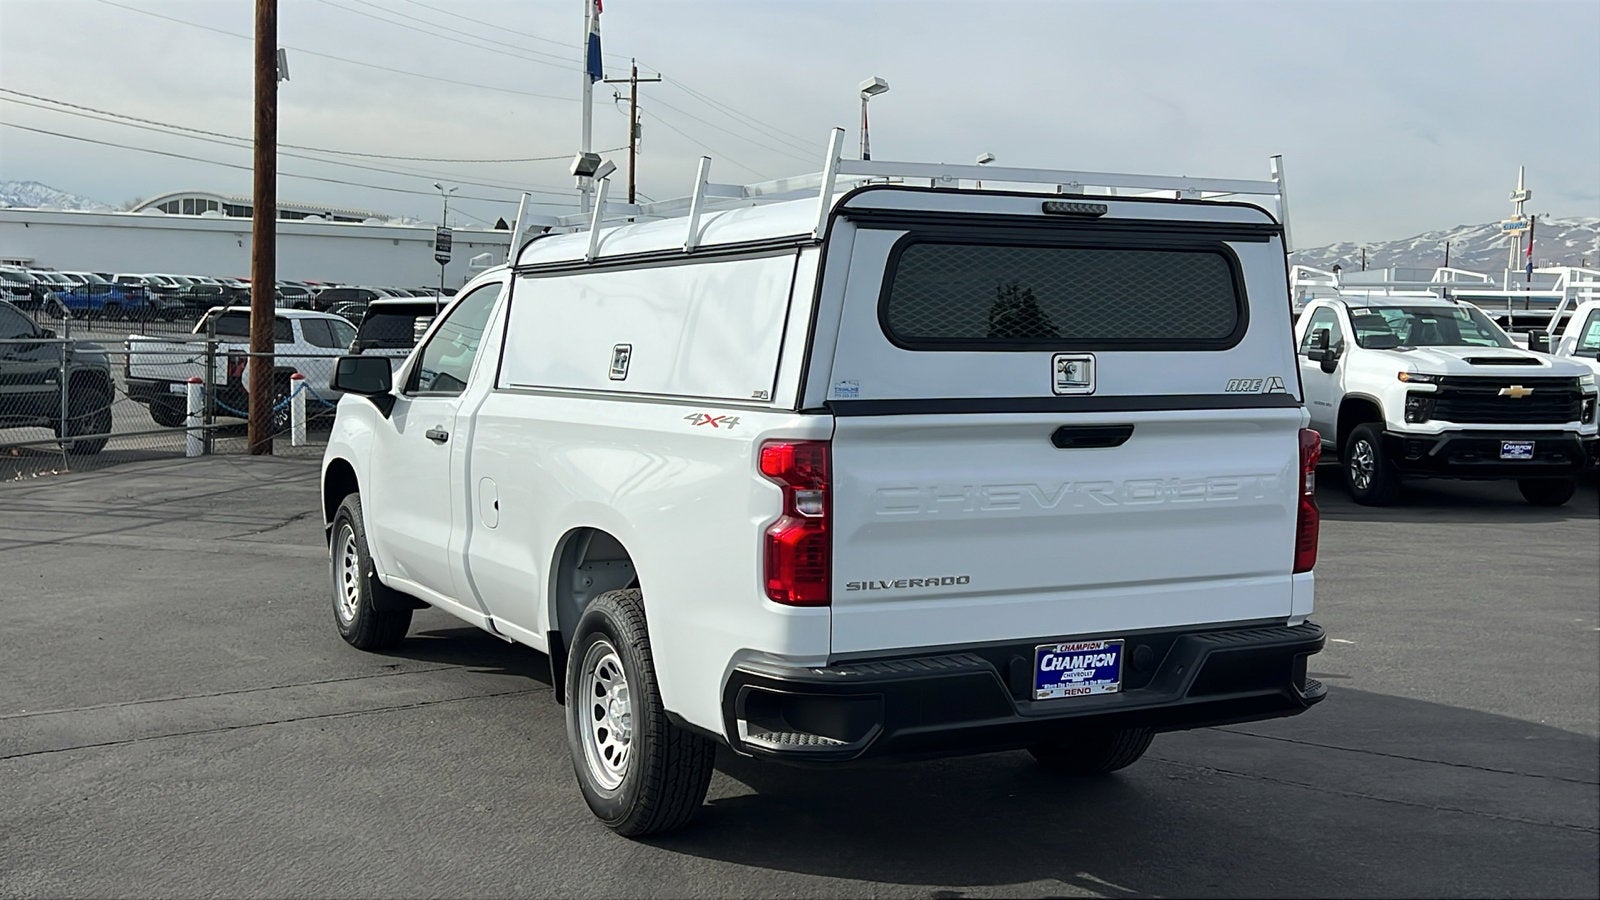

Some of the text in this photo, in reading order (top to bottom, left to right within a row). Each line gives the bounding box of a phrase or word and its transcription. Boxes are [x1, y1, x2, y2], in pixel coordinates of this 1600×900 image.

[1225, 378, 1263, 393] ARE
[875, 473, 1277, 516] CHEVROLET
[846, 575, 970, 592] SILVERADO
[1060, 642, 1102, 651] CHAMPION
[1041, 653, 1116, 671] CHAMPION
[1063, 671, 1093, 679] CHEVROLET
[1064, 687, 1092, 696] RENO
